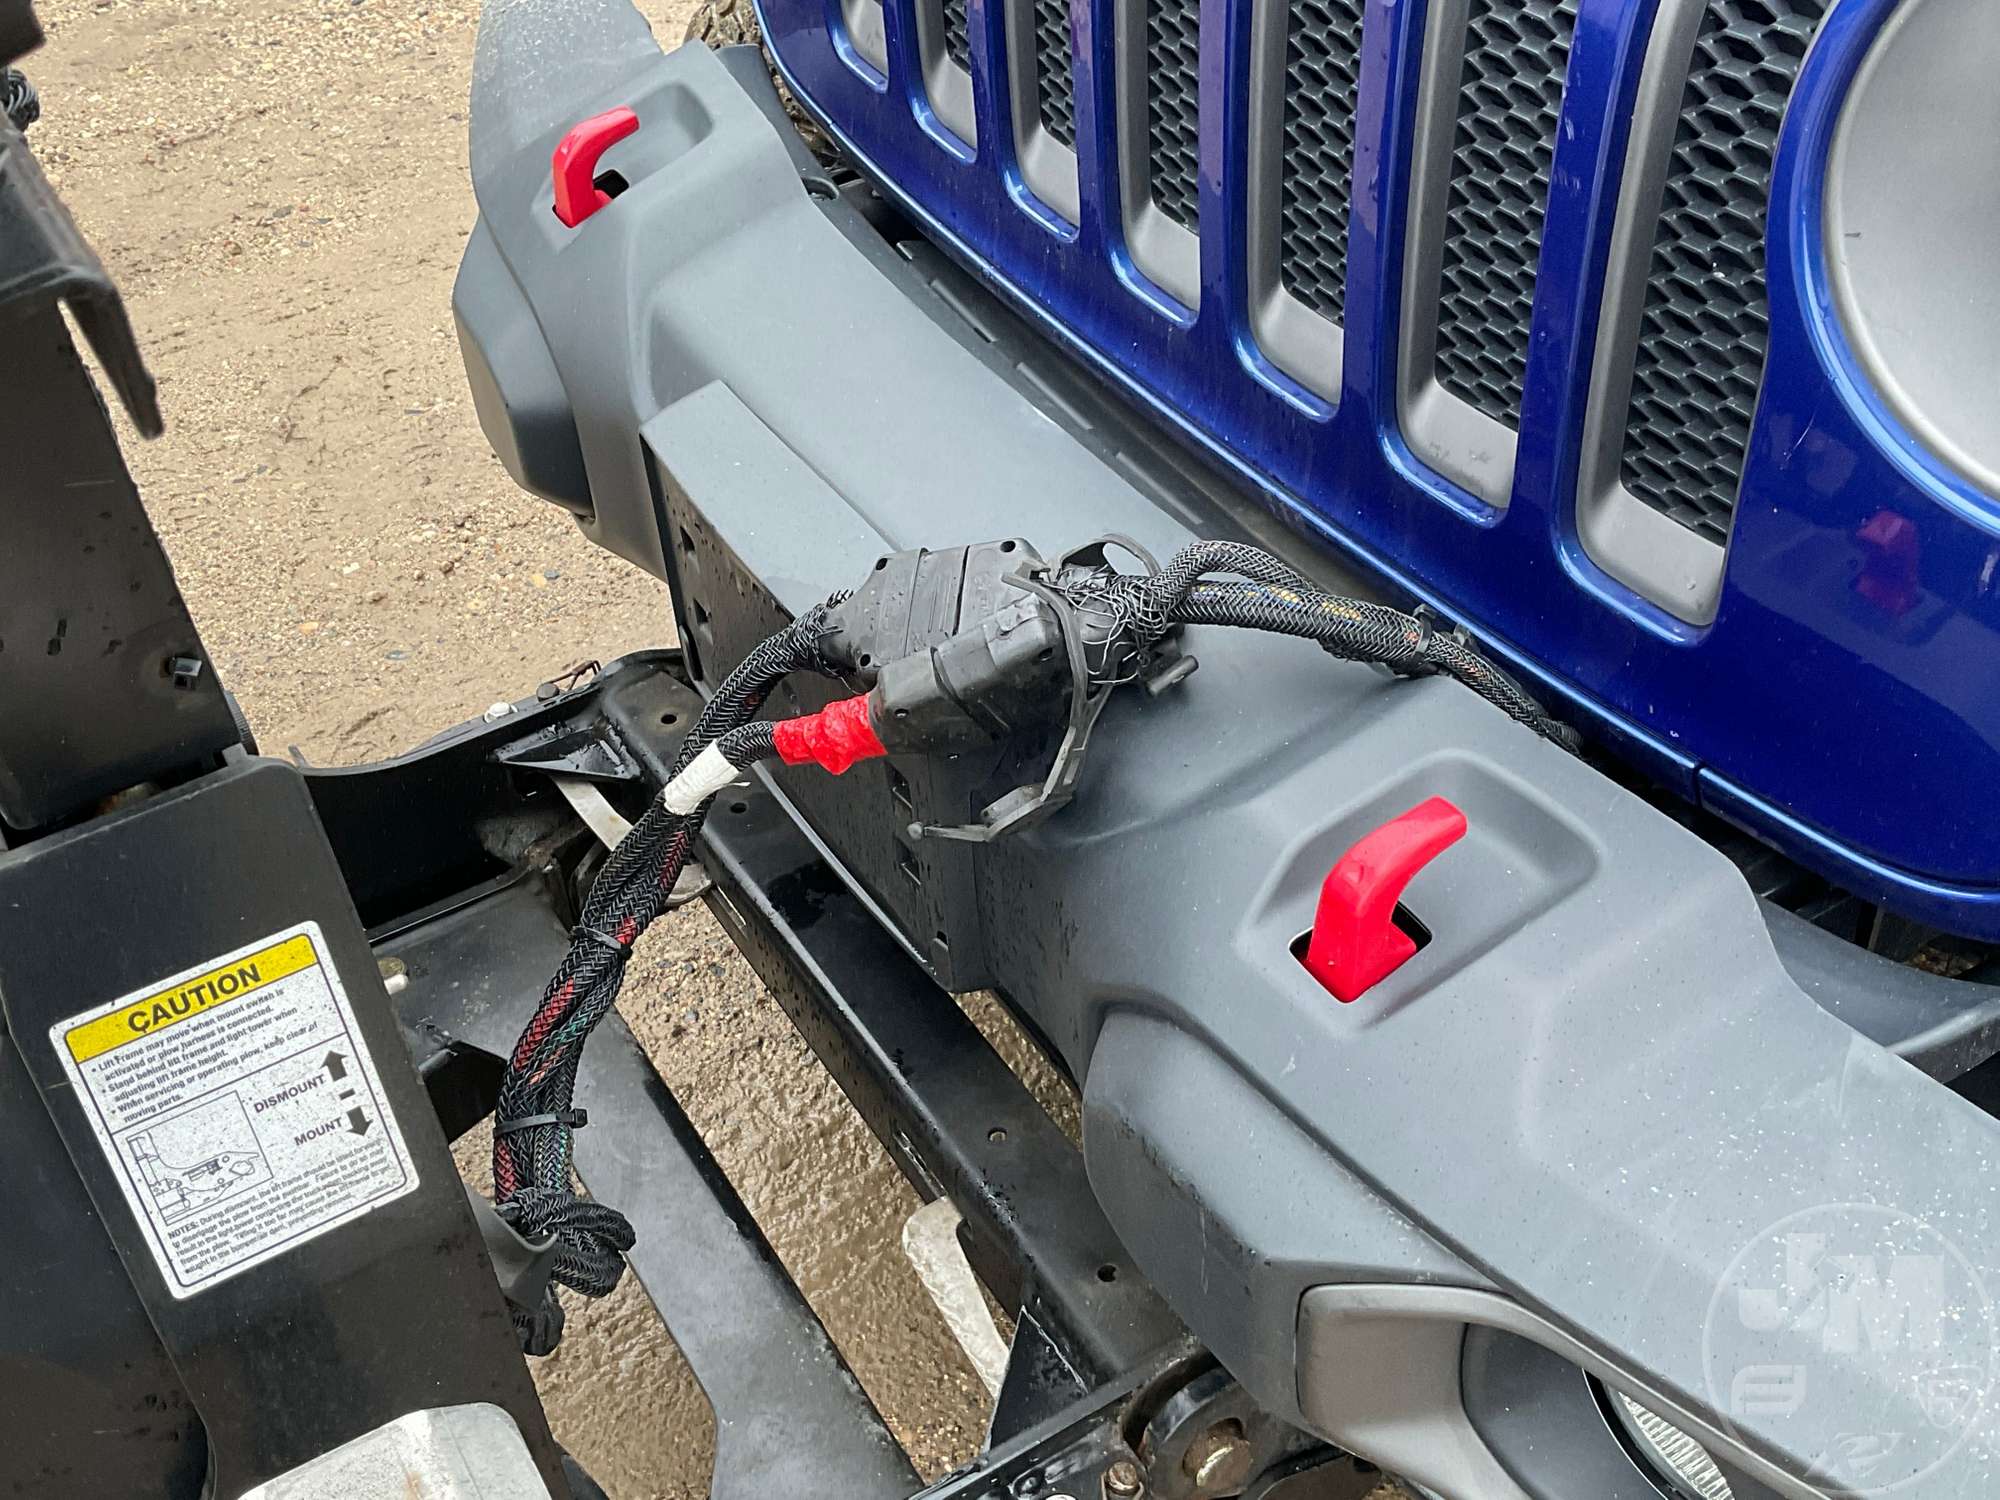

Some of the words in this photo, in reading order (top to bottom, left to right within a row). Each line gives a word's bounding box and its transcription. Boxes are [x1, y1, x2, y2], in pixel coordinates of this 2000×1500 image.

[128, 963, 260, 1032] CAUTION
[97, 1058, 115, 1071] Lift
[113, 1047, 144, 1064] Frame
[145, 1039, 164, 1052] may
[165, 1028, 190, 1044] move
[189, 1017, 216, 1032] when
[215, 1004, 245, 1022] mount
[274, 988, 284, 997] is
[104, 1058, 146, 1081] activated
[146, 1054, 156, 1064] or
[157, 1045, 180, 1061] plow
[179, 1029, 216, 1050] harness
[216, 1025, 226, 1034] is
[226, 1004, 274, 1030] connected.
[107, 1075, 135, 1092] Stand
[135, 1061, 167, 1081] behind
[166, 1056, 181, 1067] lift
[181, 1045, 208, 1061] frame
[209, 1036, 226, 1050] and
[225, 1027, 248, 1042] light
[247, 1017, 272, 1033] tower
[273, 1007, 298, 1022] when
[113, 1080, 156, 1102] adjusting
[155, 1073, 170, 1085] lift
[170, 1062, 197, 1078] frame
[197, 1049, 228, 1067] height.
[116, 1097, 144, 1112] When
[144, 1080, 186, 1102] servicing
[185, 1075, 195, 1084] or
[239, 1047, 263, 1063] plow,
[285, 1026, 307, 1041] clear
[253, 1074, 324, 1113] DISMOUNT
[123, 1104, 157, 1123] moving
[157, 1093, 184, 1110] parts.
[294, 1116, 342, 1146] MOUNT
[167, 1221, 199, 1239] NOTES:
[199, 1210, 225, 1226] During
[280, 1174, 303, 1188] frame
[302, 1162, 326, 1178] should
[217, 1217, 231, 1227] the
[231, 1209, 250, 1222] plow
[249, 1200, 268, 1212] from
[179, 1254, 198, 1266] from
